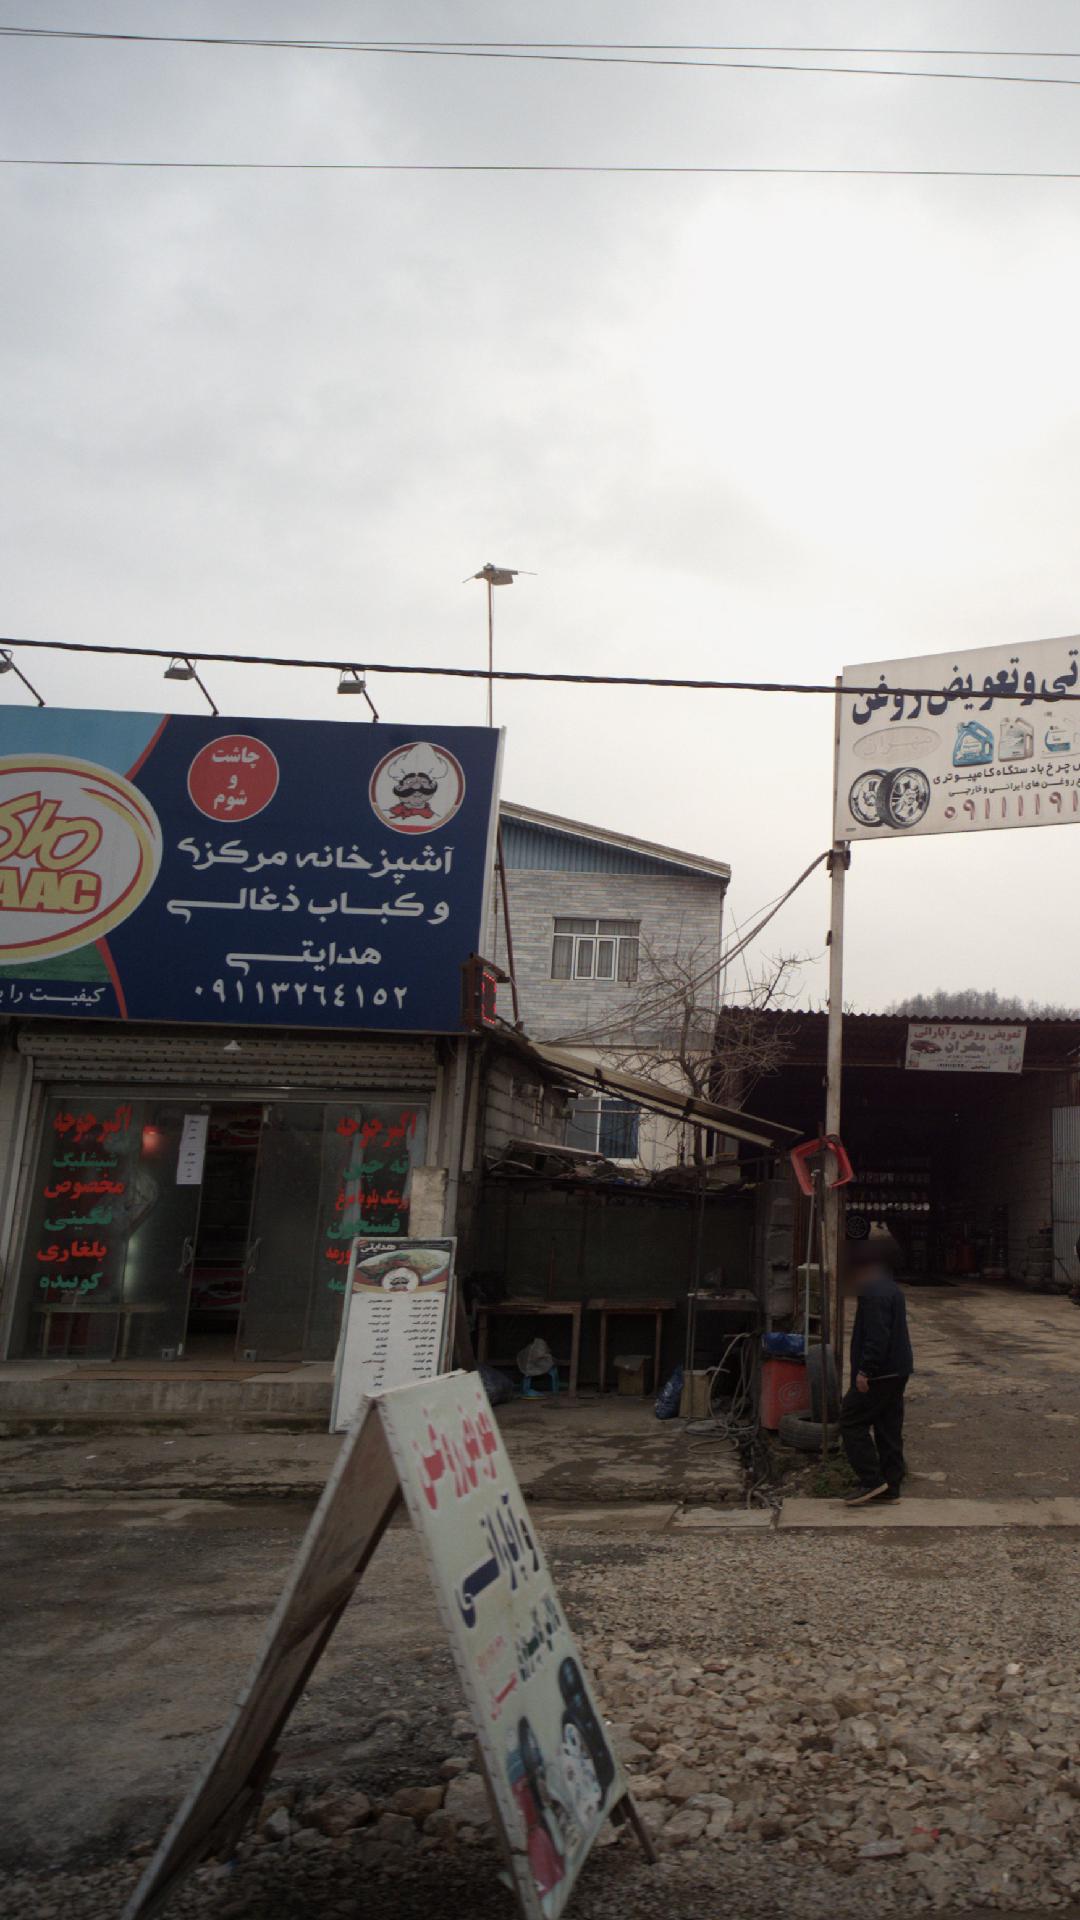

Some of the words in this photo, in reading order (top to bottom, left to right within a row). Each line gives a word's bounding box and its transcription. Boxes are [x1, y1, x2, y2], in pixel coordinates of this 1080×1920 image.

[927, 657, 1019, 716] تعویض
[852, 674, 922, 725] روغن
[211, 745, 260, 769] چاشت
[227, 774, 238, 789] و
[933, 768, 994, 785] کامپیوتری
[989, 781, 1024, 793] ایرانی
[213, 789, 248, 811] شوم
[949, 785, 982, 797] خارجی
[177, 837, 288, 873] مرکزی
[296, 844, 455, 885] آشپزخانه
[166, 884, 300, 924] ذغالی
[307, 892, 424, 924] کباب
[427, 901, 450, 925] و
[225, 940, 382, 976] هدایتی
[10, 984, 23, 1003] را
[29, 987, 107, 1006] کیفیت
[52, 1152, 118, 1171] شیشلیک
[43, 1172, 126, 1200] مخصوص
[43, 1205, 113, 1231] نگینی
[36, 1238, 108, 1263] بلغاری
